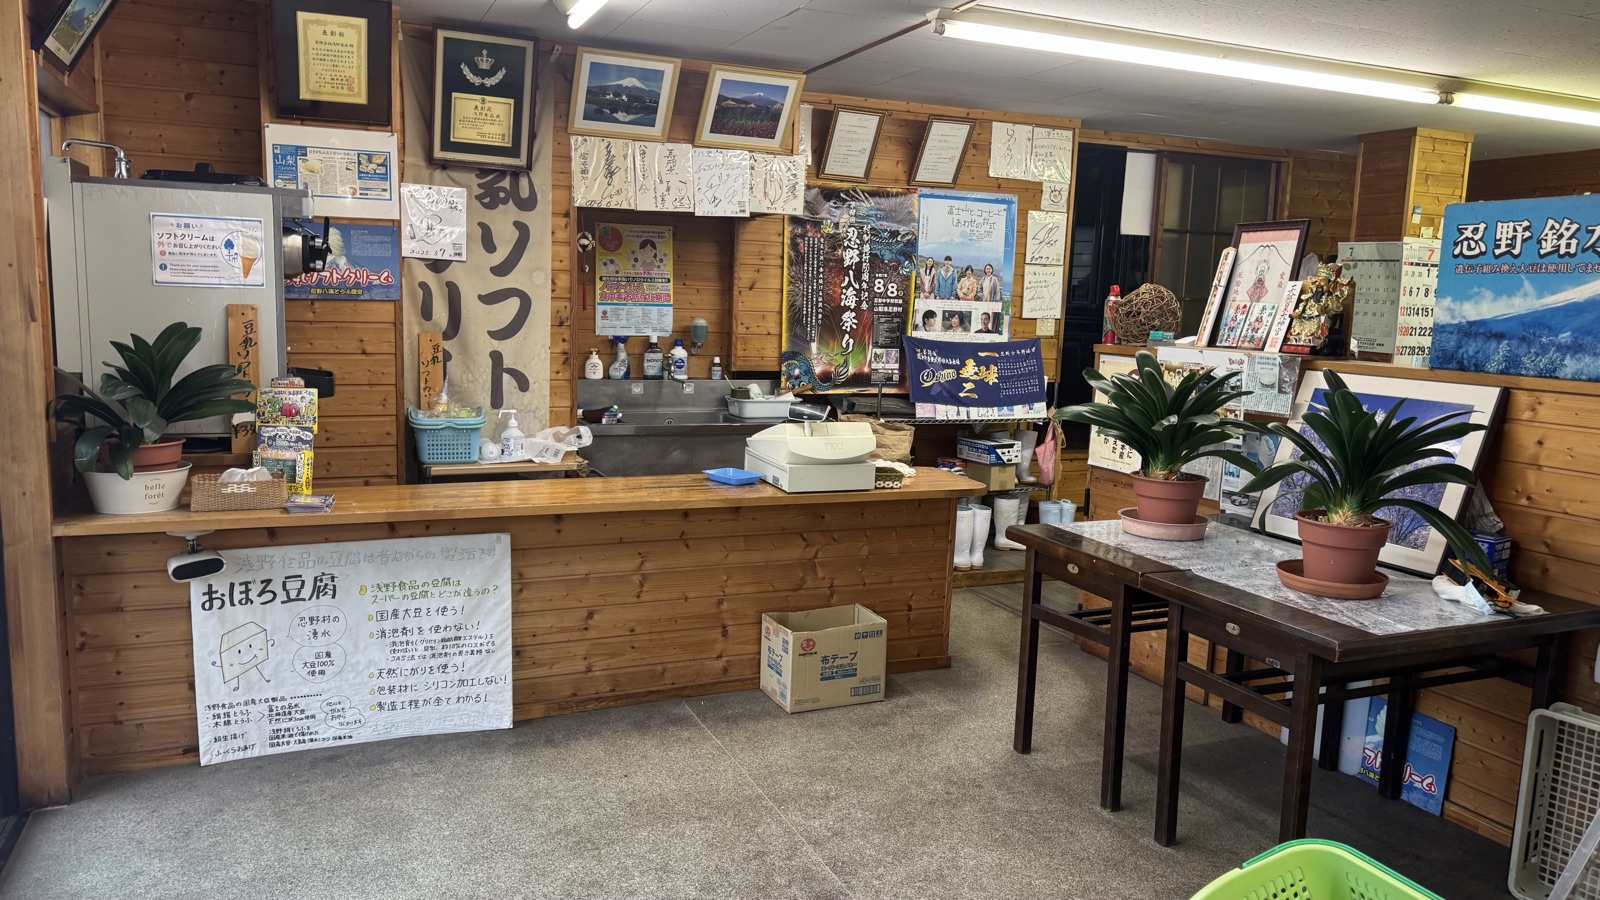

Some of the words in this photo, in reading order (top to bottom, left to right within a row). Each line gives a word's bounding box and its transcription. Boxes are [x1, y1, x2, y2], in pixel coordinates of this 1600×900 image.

[322, 29, 345, 37] 表彰状
[275, 154, 296, 166] 山梨
[157, 232, 215, 242] ソフトクリームは
[1349, 247, 1354, 257] 7
[1427, 248, 1435, 260] 7
[1427, 268, 1431, 278] 1
[841, 227, 860, 355] 忍野八海祭り
[874, 278, 898, 297] 8/8
[1402, 286, 1407, 297] 5
[1409, 286, 1413, 297] 6
[1415, 287, 1420, 297] 7
[1424, 287, 1430, 298] 8
[1405, 306, 1412, 317] 13
[1412, 307, 1420, 317] 14
[1420, 307, 1430, 317] 15
[1403, 326, 1409, 336] 20
[1409, 326, 1417, 336] 21
[1419, 326, 1428, 336] 22
[1400, 346, 1407, 355] 27
[1407, 346, 1415, 355] 28
[1416, 346, 1425, 356] 29
[920, 368, 957, 384] Oshino
[371, 577, 461, 592] 浅野食品の豆腐は
[200, 572, 339, 611] おぼろ豆腐
[376, 605, 465, 622] 国産大豆を使う!
[298, 615, 340, 627] 忍野村の
[307, 629, 331, 640] 湧水
[315, 651, 332, 659] 国産
[821, 652, 858, 665] 布テープ
[302, 660, 335, 669] 大豆100%
[377, 662, 465, 679] 天然にがりを使う!
